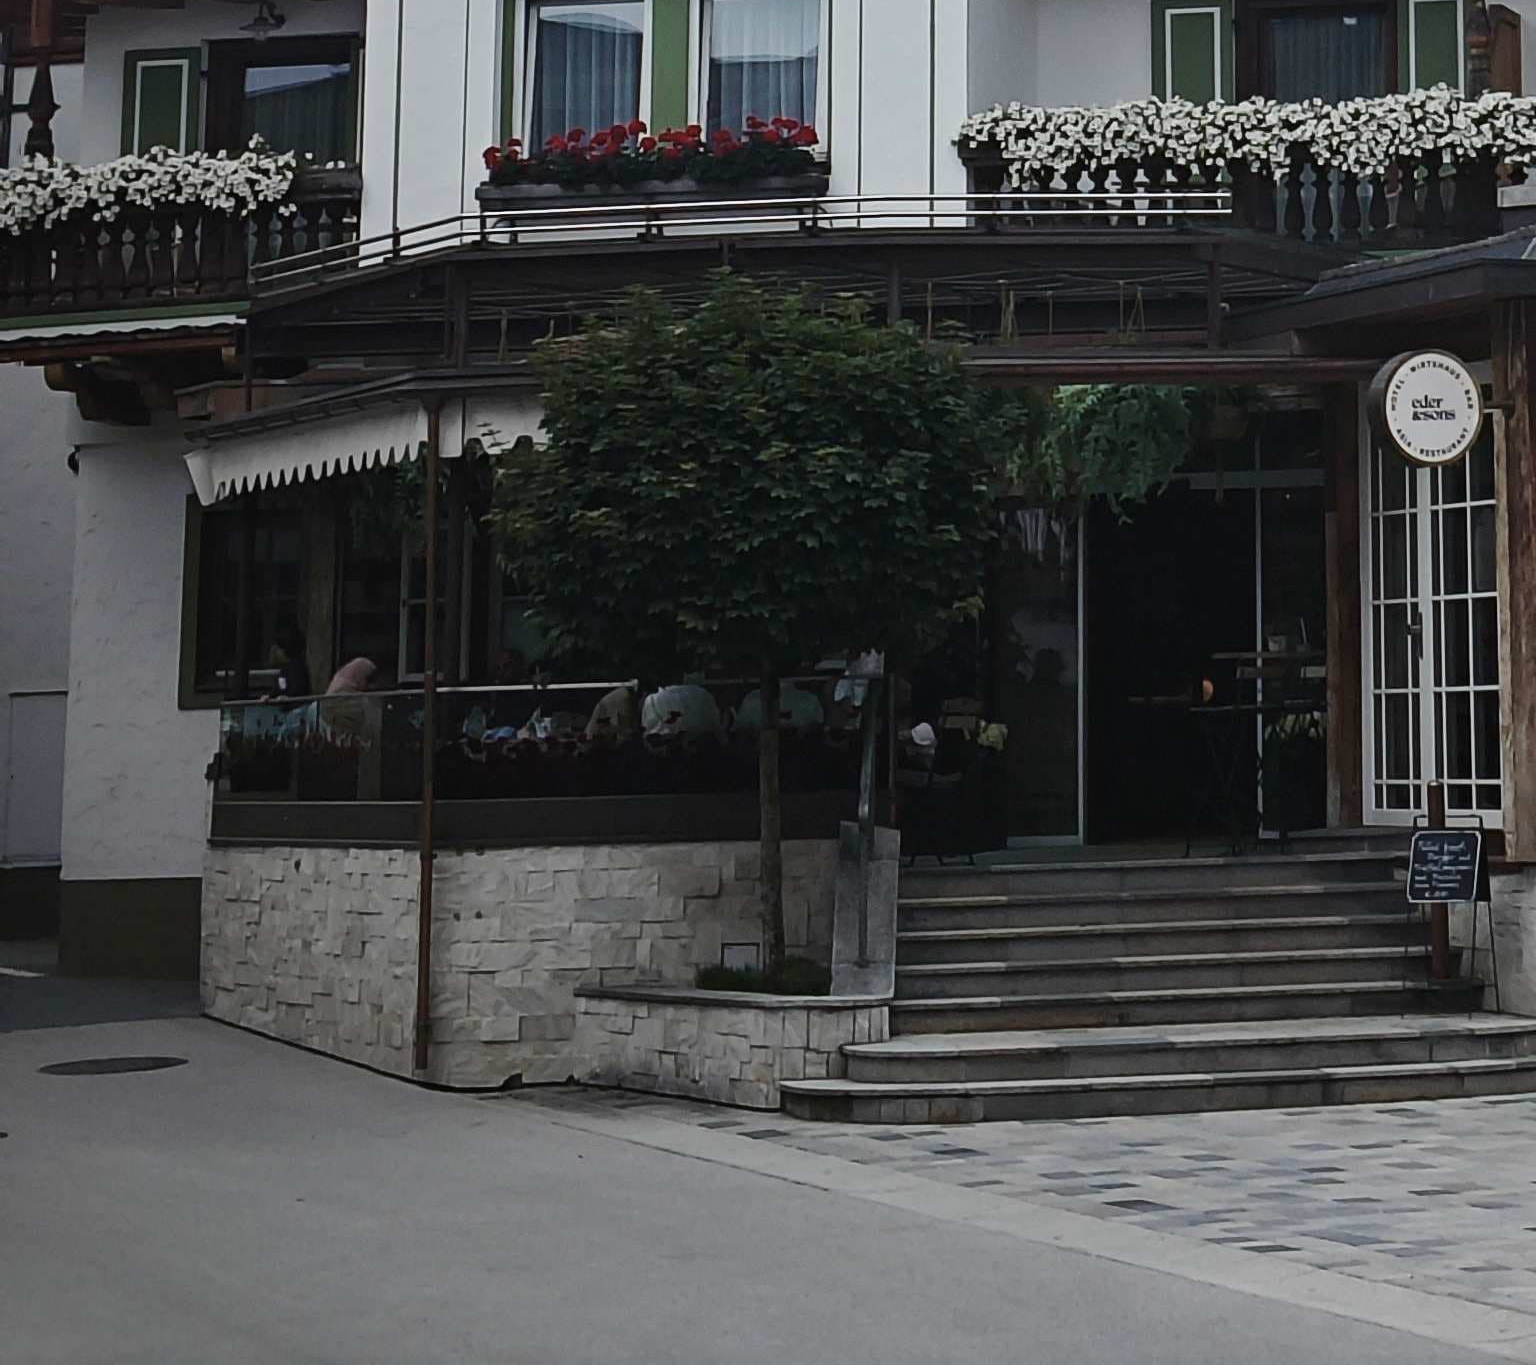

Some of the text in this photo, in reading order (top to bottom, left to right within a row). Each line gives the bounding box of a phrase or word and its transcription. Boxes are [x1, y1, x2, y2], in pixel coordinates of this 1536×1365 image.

[1391, 379, 1405, 411] HOTEL
[1411, 394, 1443, 408] eder
[1420, 427, 1469, 457] RESTAURANT
